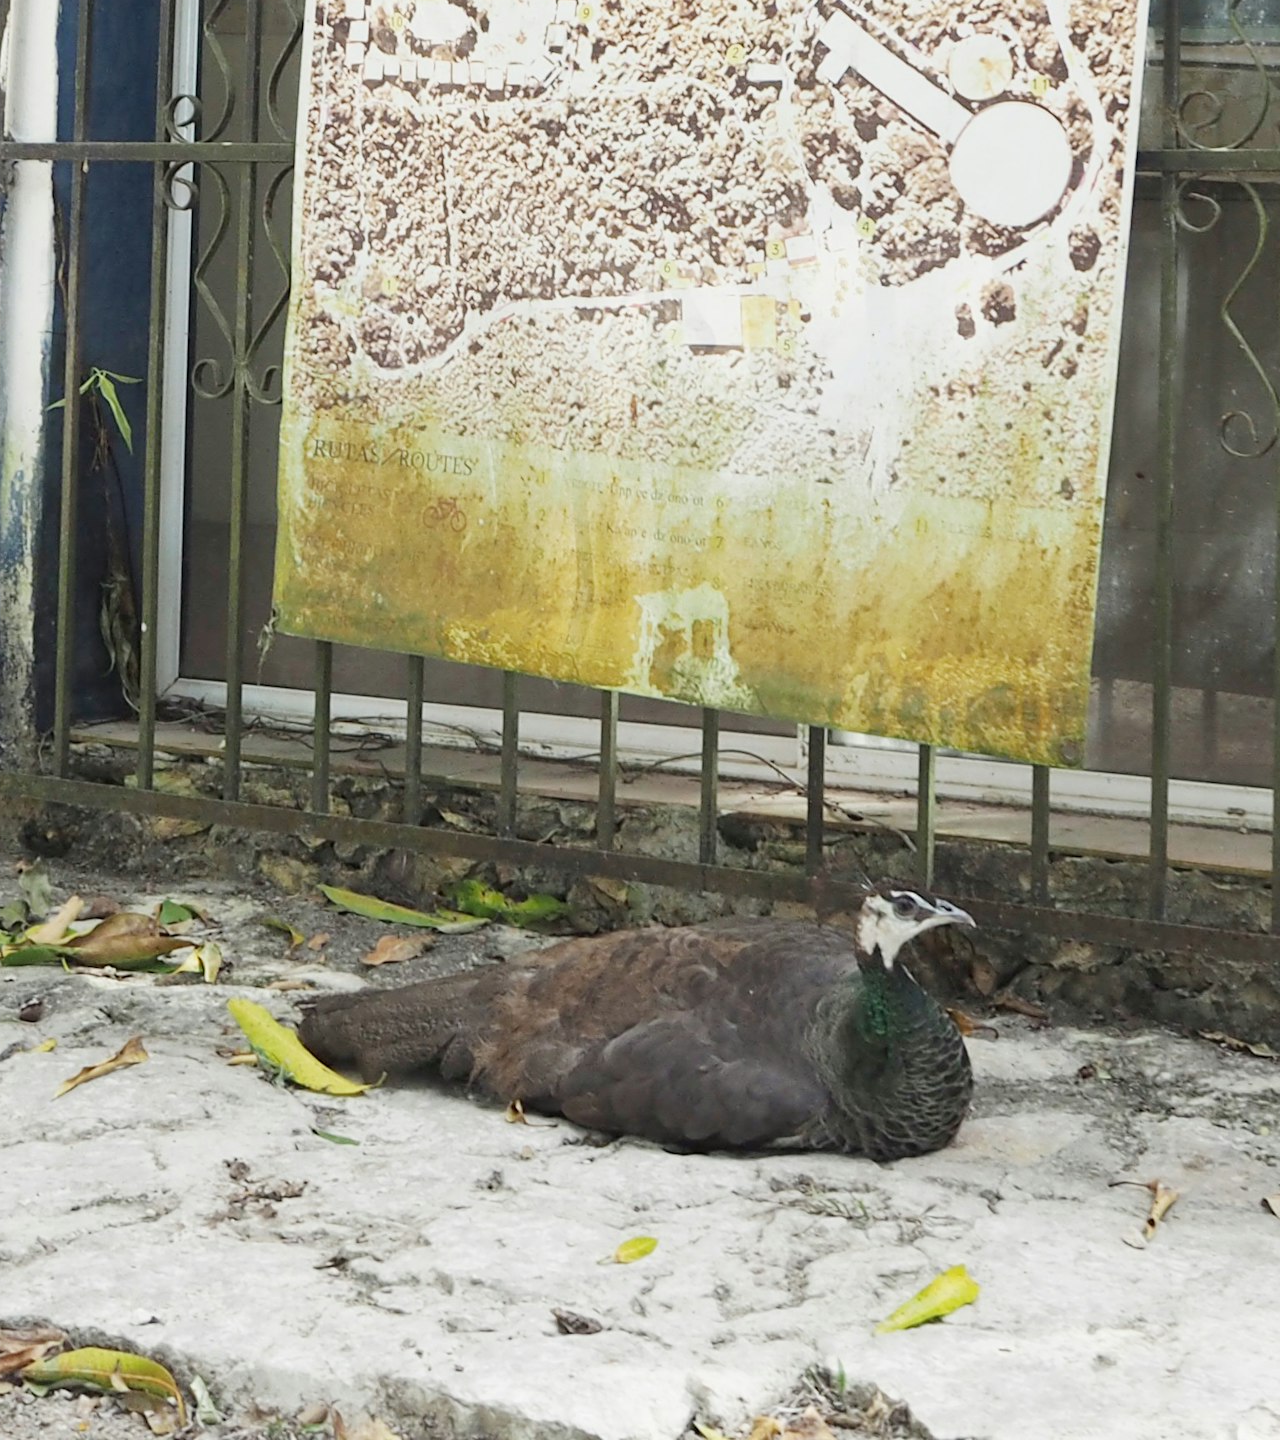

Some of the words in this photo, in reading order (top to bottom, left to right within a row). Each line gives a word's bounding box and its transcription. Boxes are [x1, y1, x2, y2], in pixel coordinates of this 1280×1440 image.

[582, 7, 591, 19] 9
[732, 47, 739, 59] 2
[861, 221, 870, 233] 4
[771, 243, 780, 256] 3
[663, 261, 672, 274] 6
[783, 339, 791, 351] 5
[715, 535, 724, 549] 7
